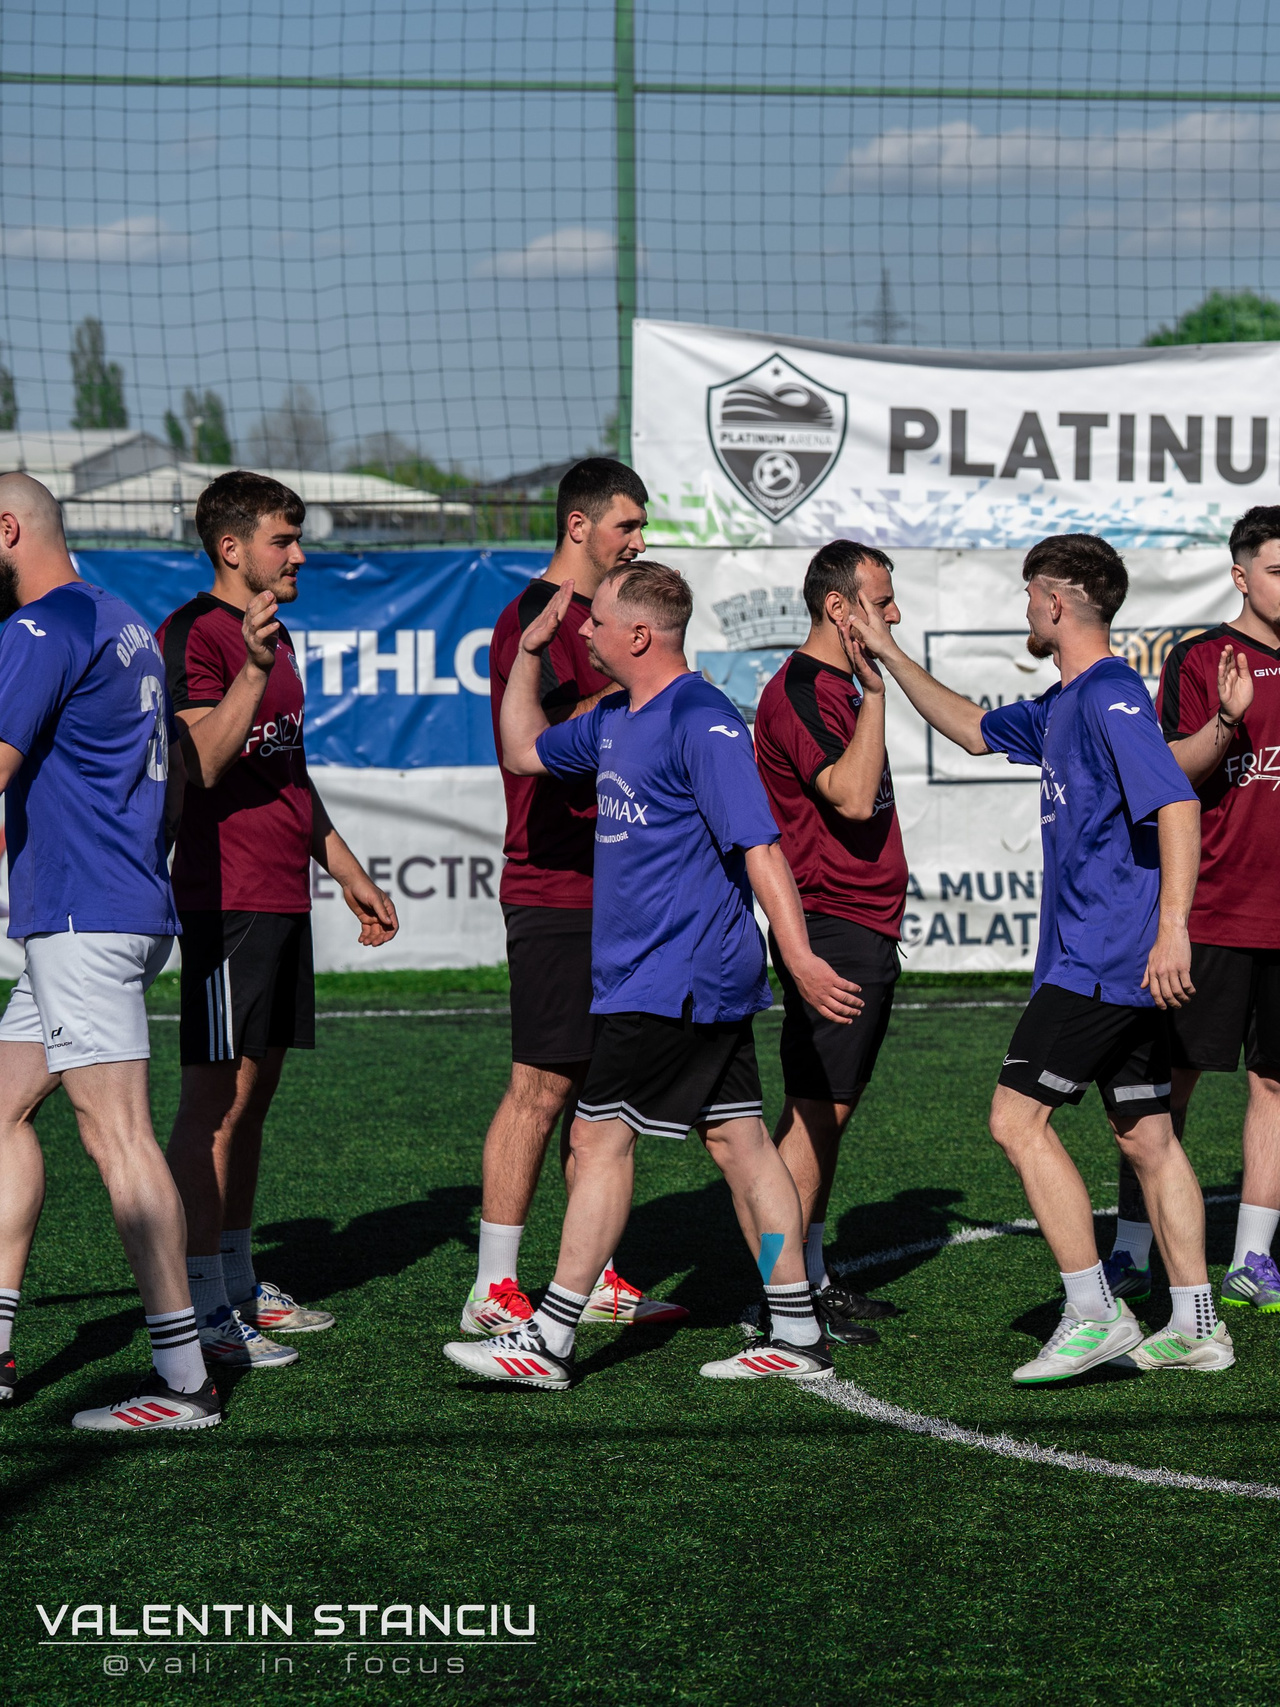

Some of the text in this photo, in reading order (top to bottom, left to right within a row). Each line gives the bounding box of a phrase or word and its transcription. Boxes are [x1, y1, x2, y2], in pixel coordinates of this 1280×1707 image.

[720, 431, 832, 445] PLATINUM ARENA
[939, 871, 1043, 901] MUN
